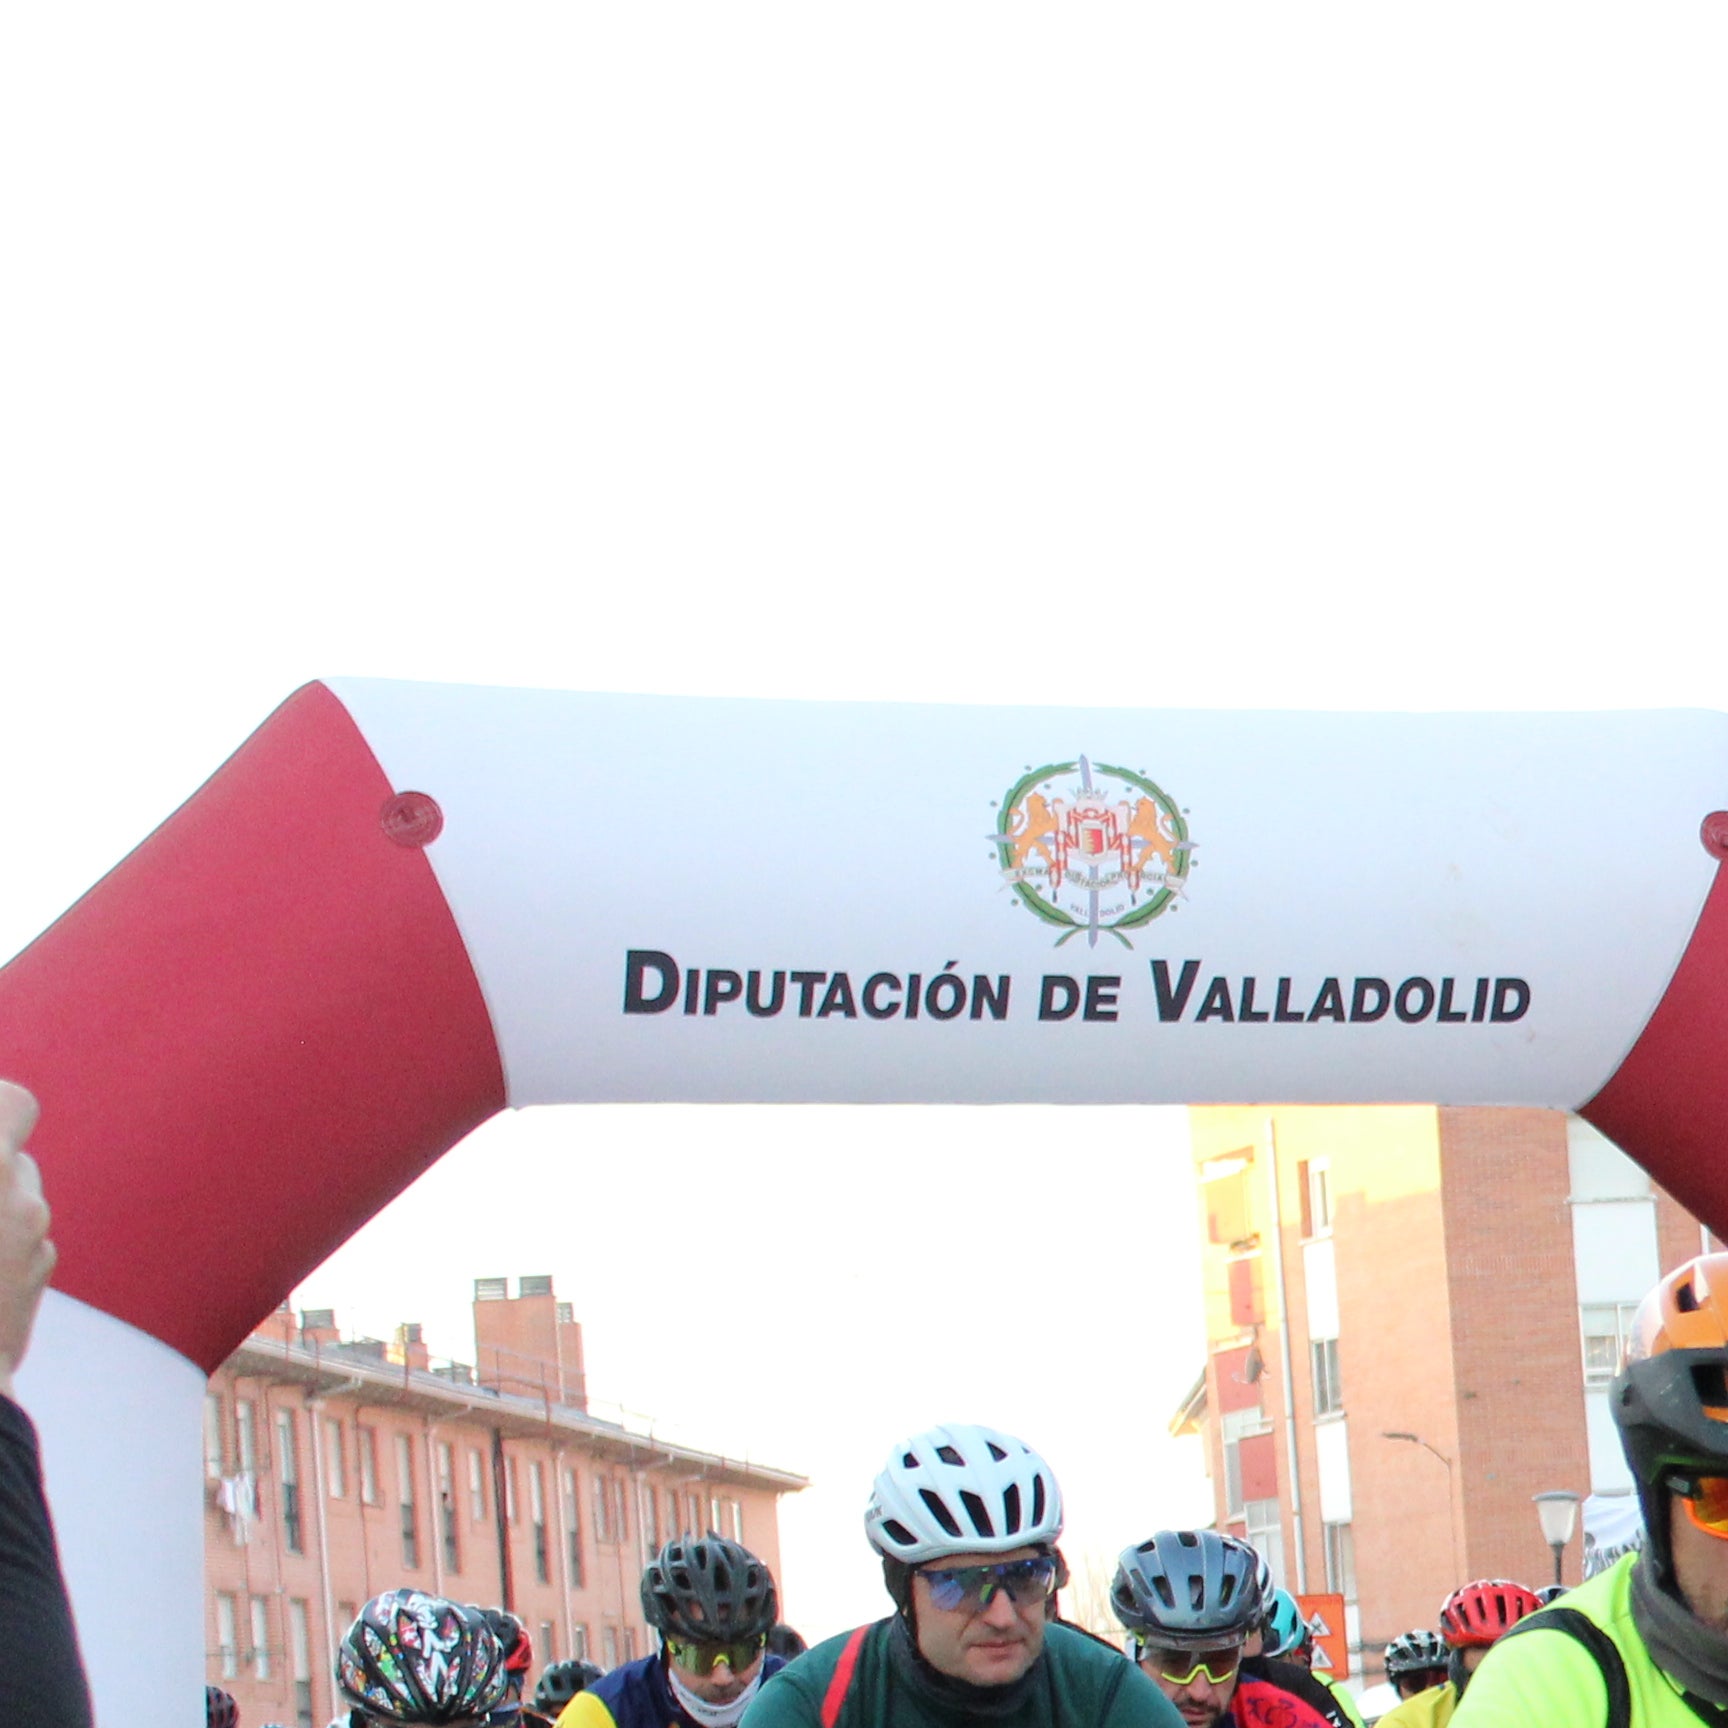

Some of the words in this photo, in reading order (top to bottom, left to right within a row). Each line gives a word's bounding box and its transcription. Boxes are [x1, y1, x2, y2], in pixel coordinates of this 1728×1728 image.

[622, 949, 1012, 1021] DIPUTACIÓN
[1038, 975, 1122, 1022] DE
[1150, 959, 1531, 1024] VALLADOLID
